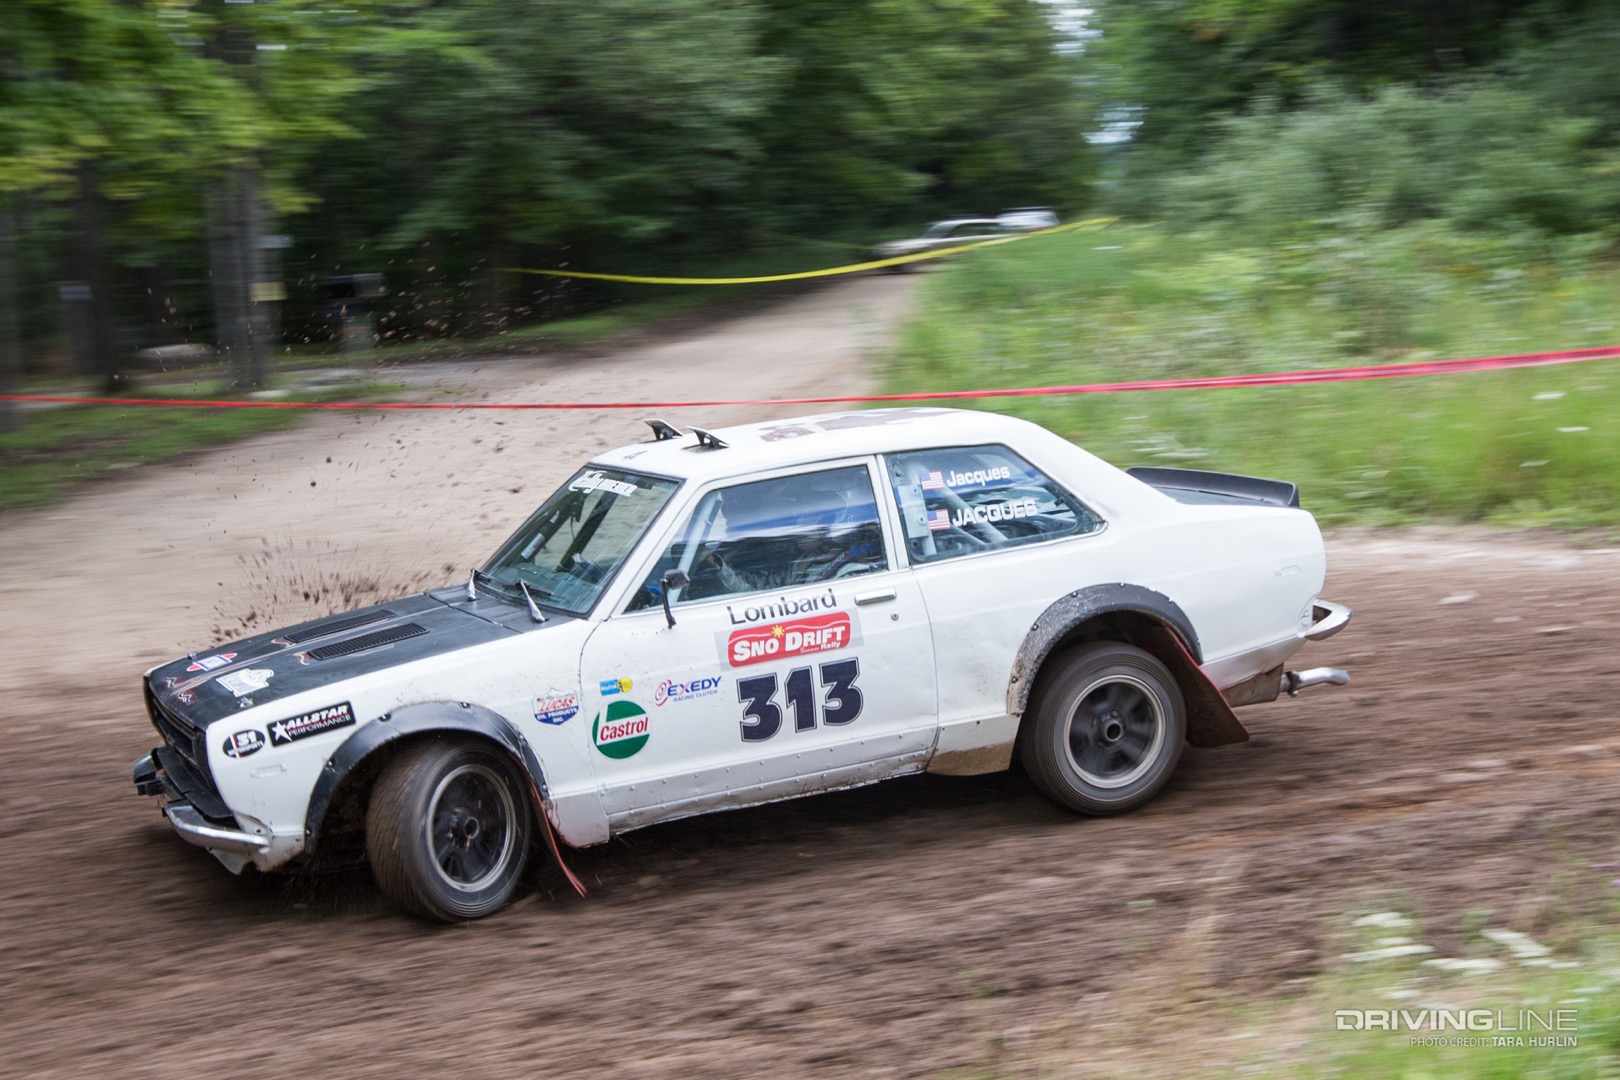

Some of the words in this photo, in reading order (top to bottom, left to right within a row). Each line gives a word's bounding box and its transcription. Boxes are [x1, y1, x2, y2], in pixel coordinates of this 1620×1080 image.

[947, 466, 1010, 487] Jacques
[952, 499, 1038, 527] JACQUES
[727, 588, 838, 625] Lombard
[733, 638, 779, 662] SNO
[785, 625, 846, 652] DRIFT
[820, 641, 841, 650] Rally
[667, 676, 722, 697] EXEDY
[673, 694, 694, 702] RACING
[695, 689, 718, 698] CLUTCH
[736, 656, 864, 742] 313
[285, 704, 349, 730] ALLSTAR
[287, 713, 351, 737] PERFORMANCE
[600, 717, 648, 742] Castrol
